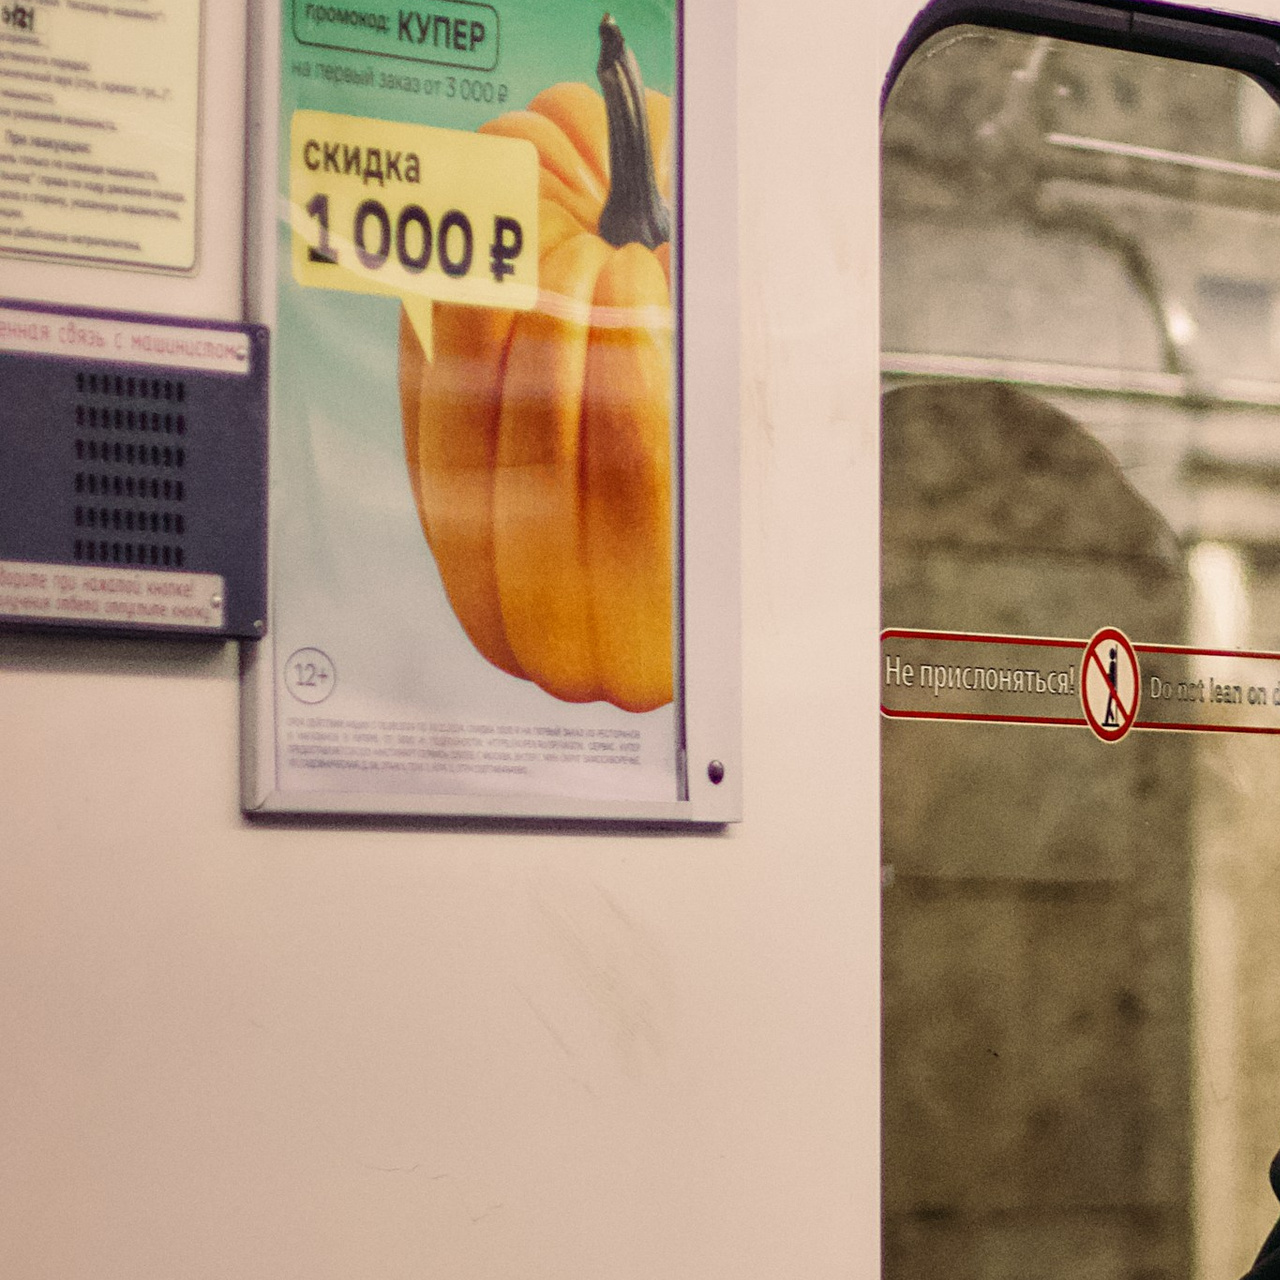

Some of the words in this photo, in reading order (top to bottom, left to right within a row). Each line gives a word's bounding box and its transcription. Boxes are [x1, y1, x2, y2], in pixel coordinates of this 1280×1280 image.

[398, 9, 486, 52] КУПЕР
[315, 62, 374, 88] первый
[379, 72, 421, 94] заказ
[303, 138, 421, 188] скидка
[294, 661, 328, 688] 12+
[885, 654, 914, 688] Не
[921, 661, 1076, 697] прислоняться!
[1149, 676, 1173, 700] Do
[1176, 680, 1205, 703] not
[1209, 677, 1243, 705] lean
[1247, 686, 1268, 706] on
